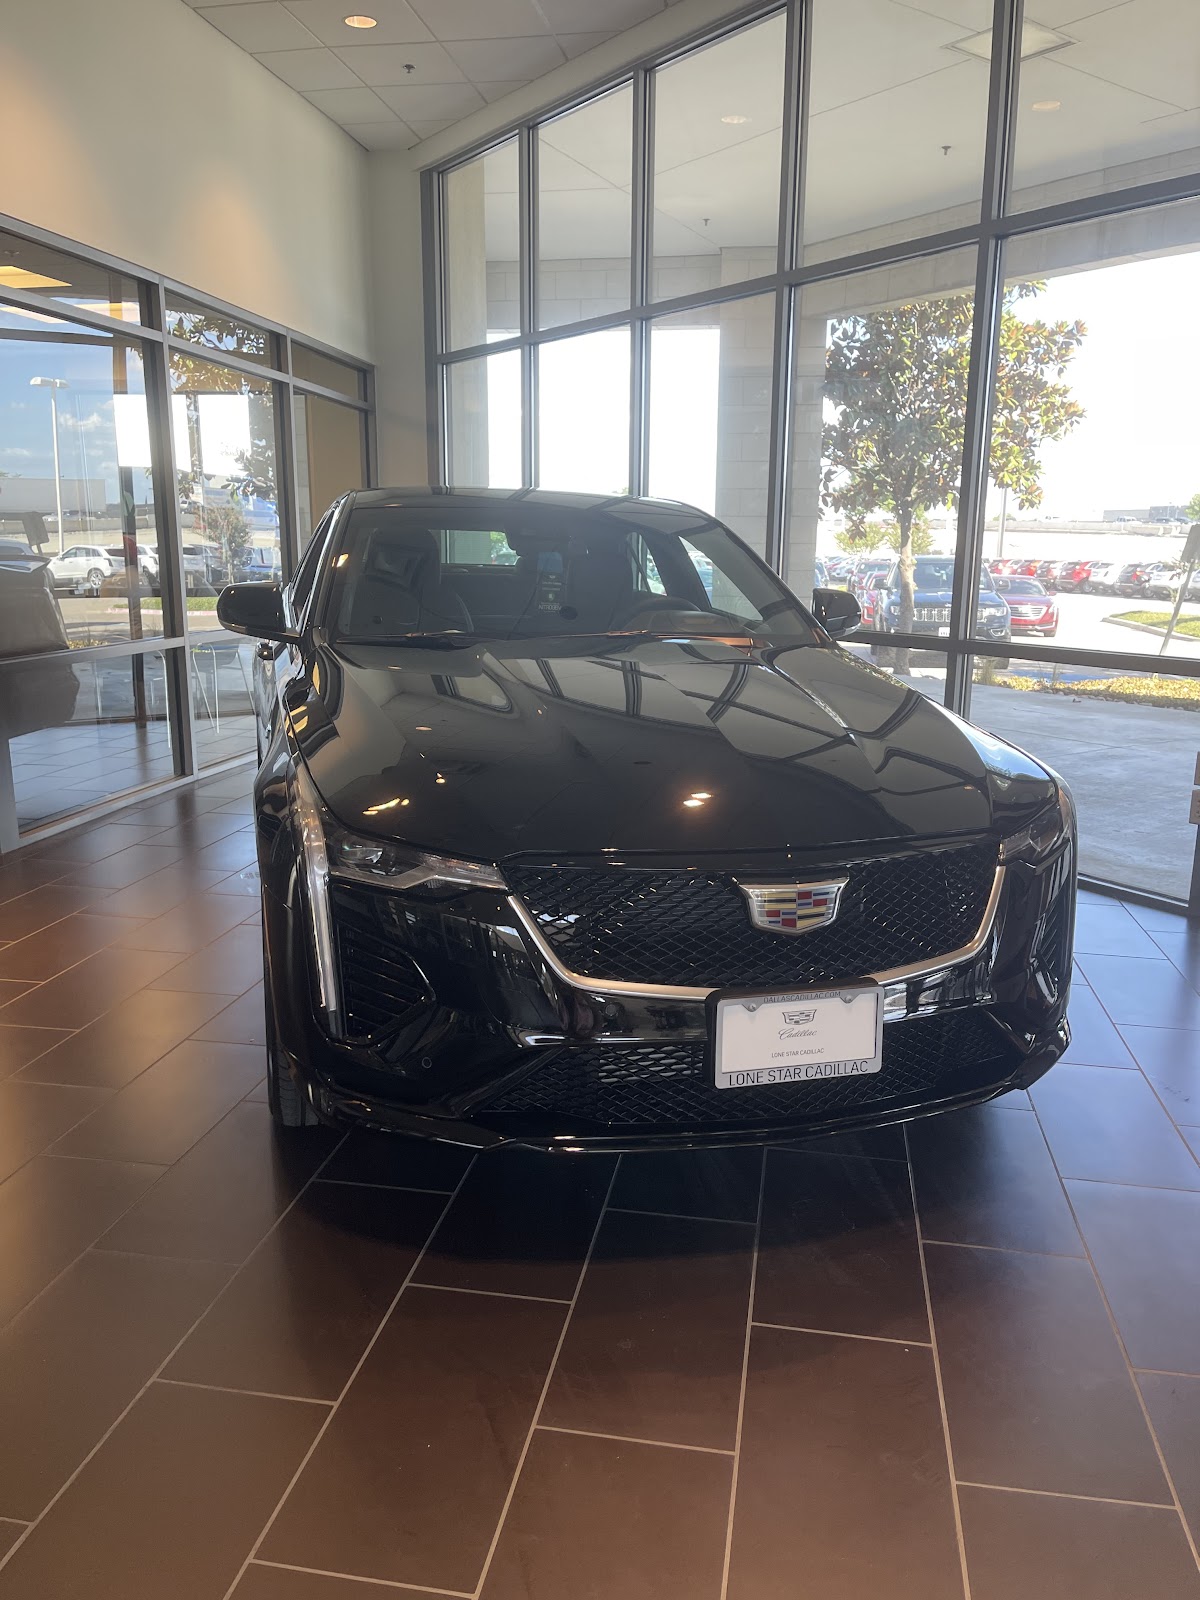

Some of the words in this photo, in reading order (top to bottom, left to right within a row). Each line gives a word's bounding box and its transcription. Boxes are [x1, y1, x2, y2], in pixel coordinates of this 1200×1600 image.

[763, 991, 841, 1003] DALLASCADILLAC.COM
[778, 1028, 817, 1040] Cadillac
[800, 1048, 825, 1056] CADILLAC
[729, 1070, 764, 1086] LONE
[767, 1067, 801, 1082] STAR
[805, 1060, 869, 1079] CADILLAC
